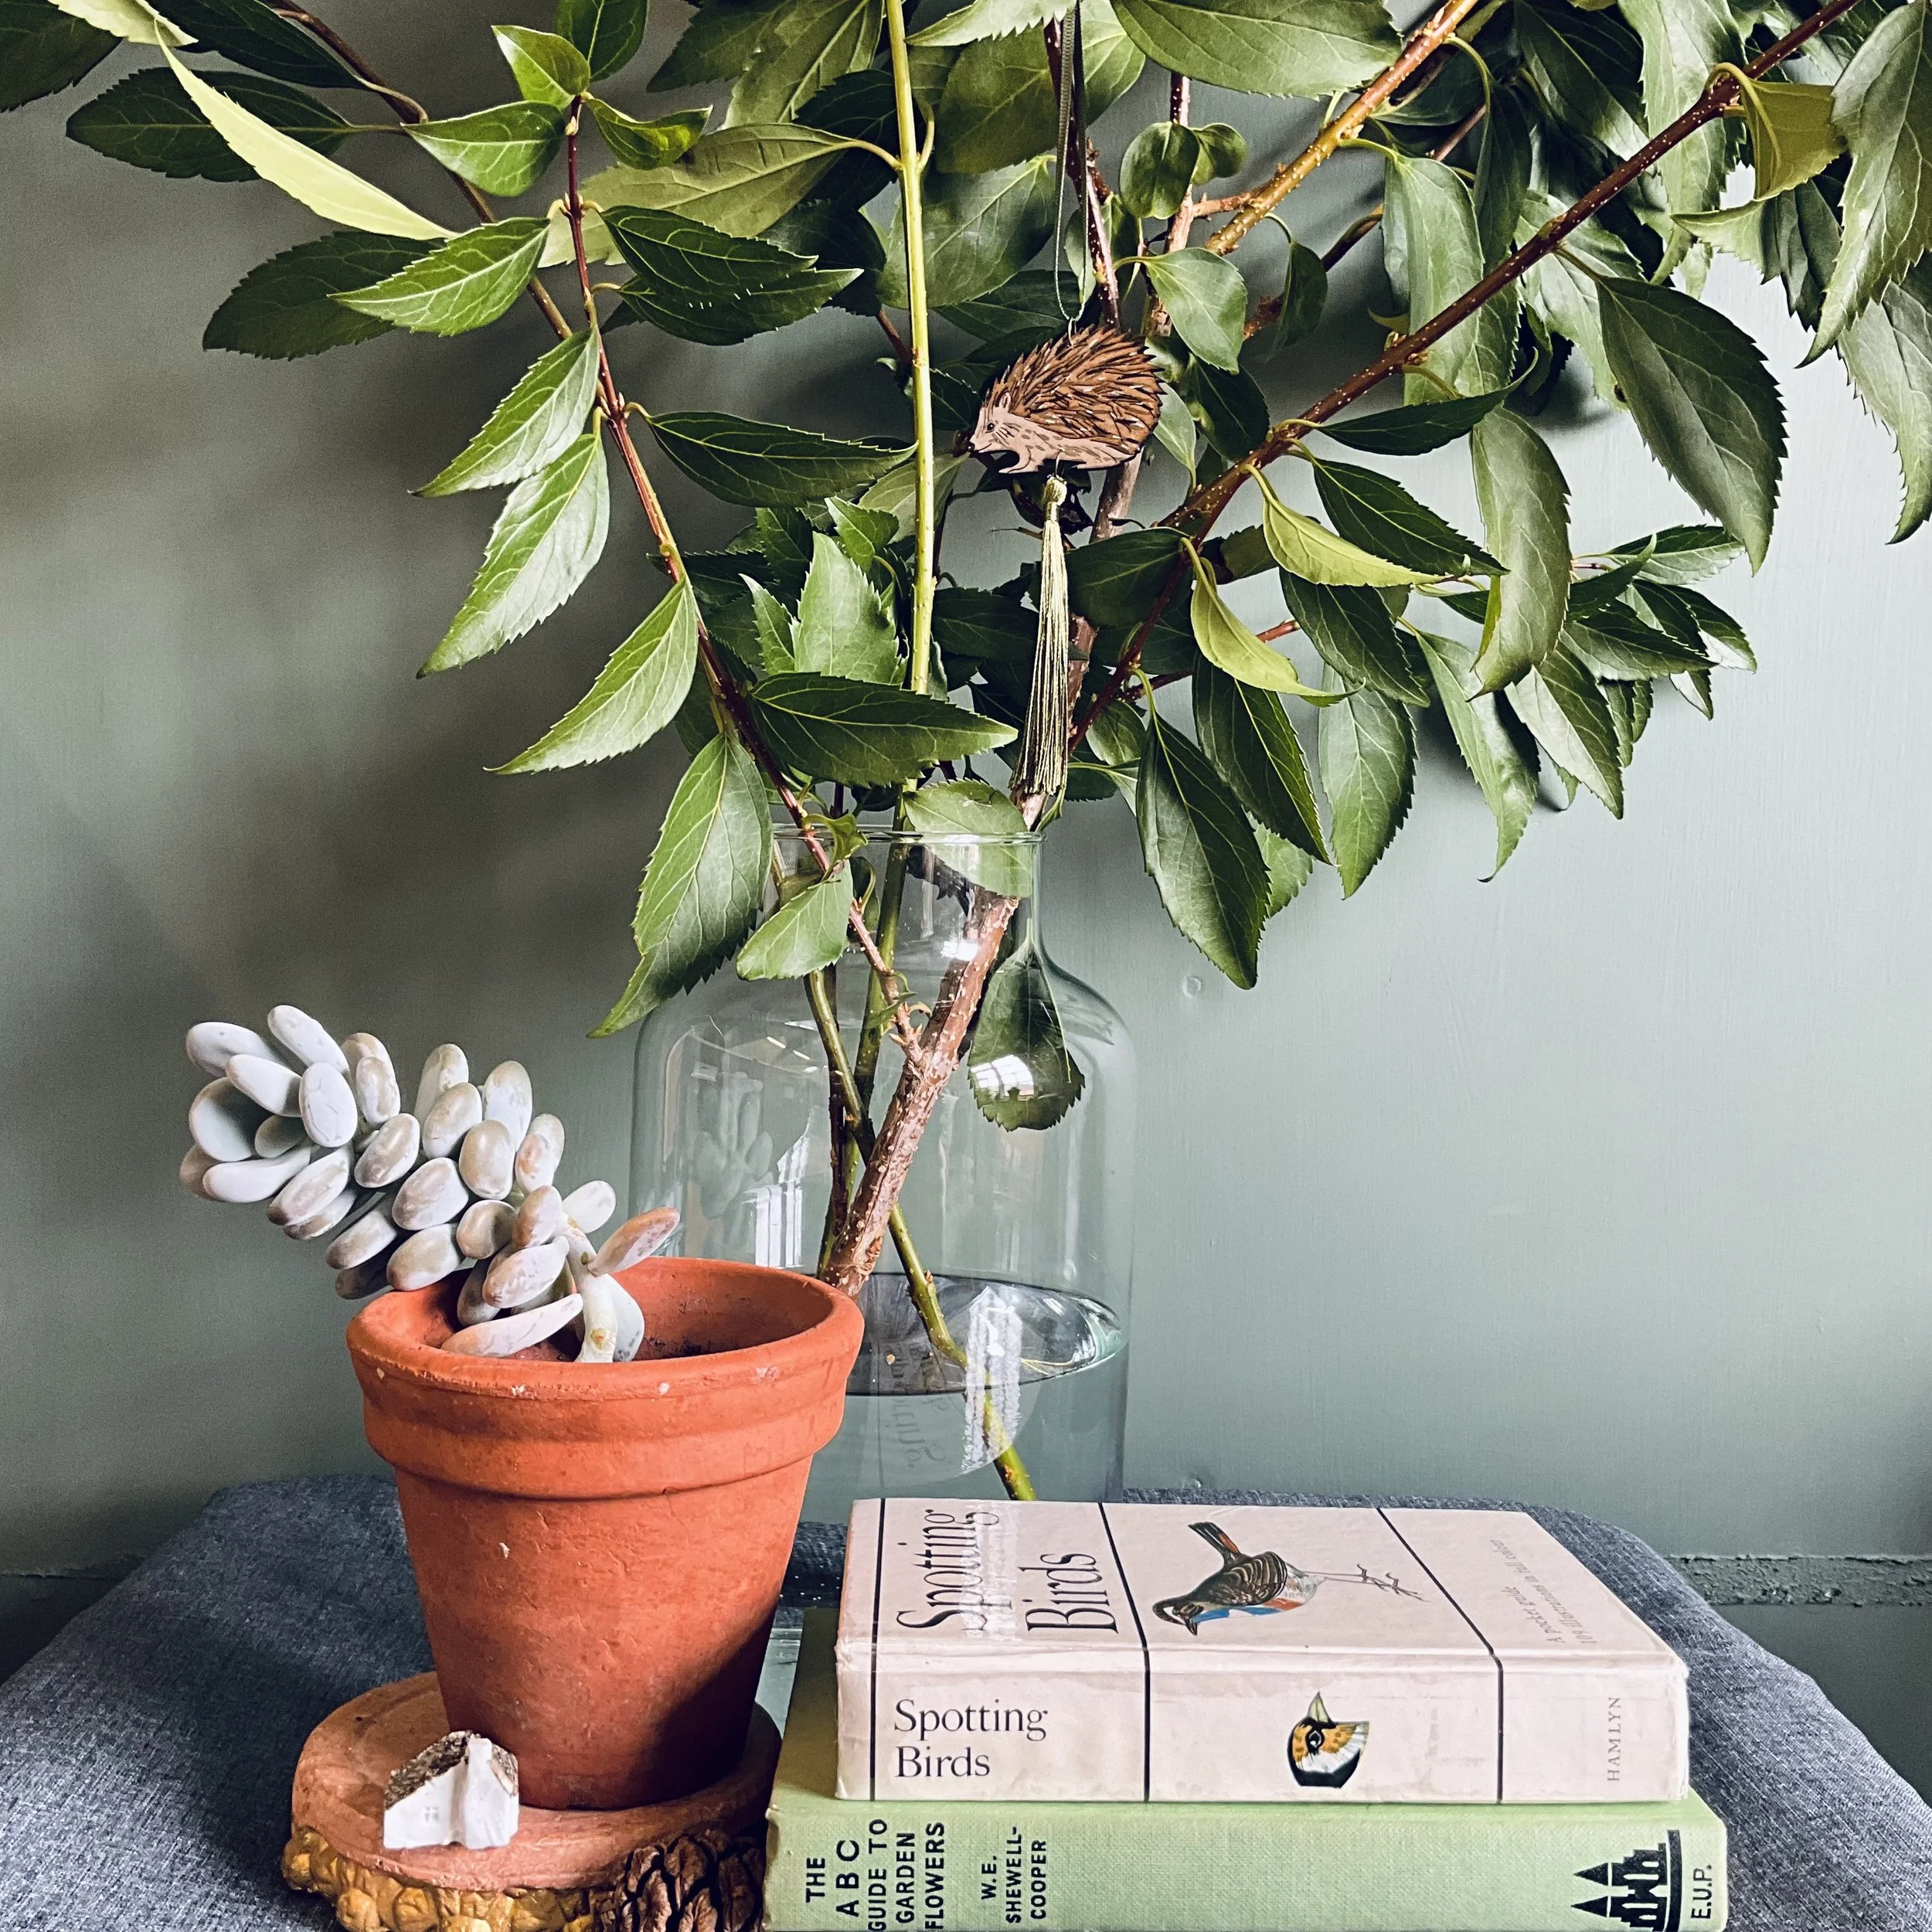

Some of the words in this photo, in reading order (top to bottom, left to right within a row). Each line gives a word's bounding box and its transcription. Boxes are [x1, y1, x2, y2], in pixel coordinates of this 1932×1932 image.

[896, 1509, 1012, 1631] Spotting
[1017, 1553, 1119, 1634] Birds
[1502, 1586, 1536, 1606] guide
[1523, 1608, 1561, 1634] pocket
[893, 1698, 1049, 1742] Spotting
[1607, 1696, 1621, 1783] HAMLYN
[894, 1745, 990, 1778] Birds
[868, 1818, 887, 1855] TO
[805, 1857, 825, 1903] THE
[868, 1868, 886, 1932] GUIDE
[896, 1832, 915, 1923] GARDEN
[925, 1821, 945, 1930] FLOWERS
[1005, 1825, 1022, 1924] SHEWELL-
[1030, 1840, 1046, 1920] COOPER
[1691, 1864, 1713, 1920] E.U.P.
